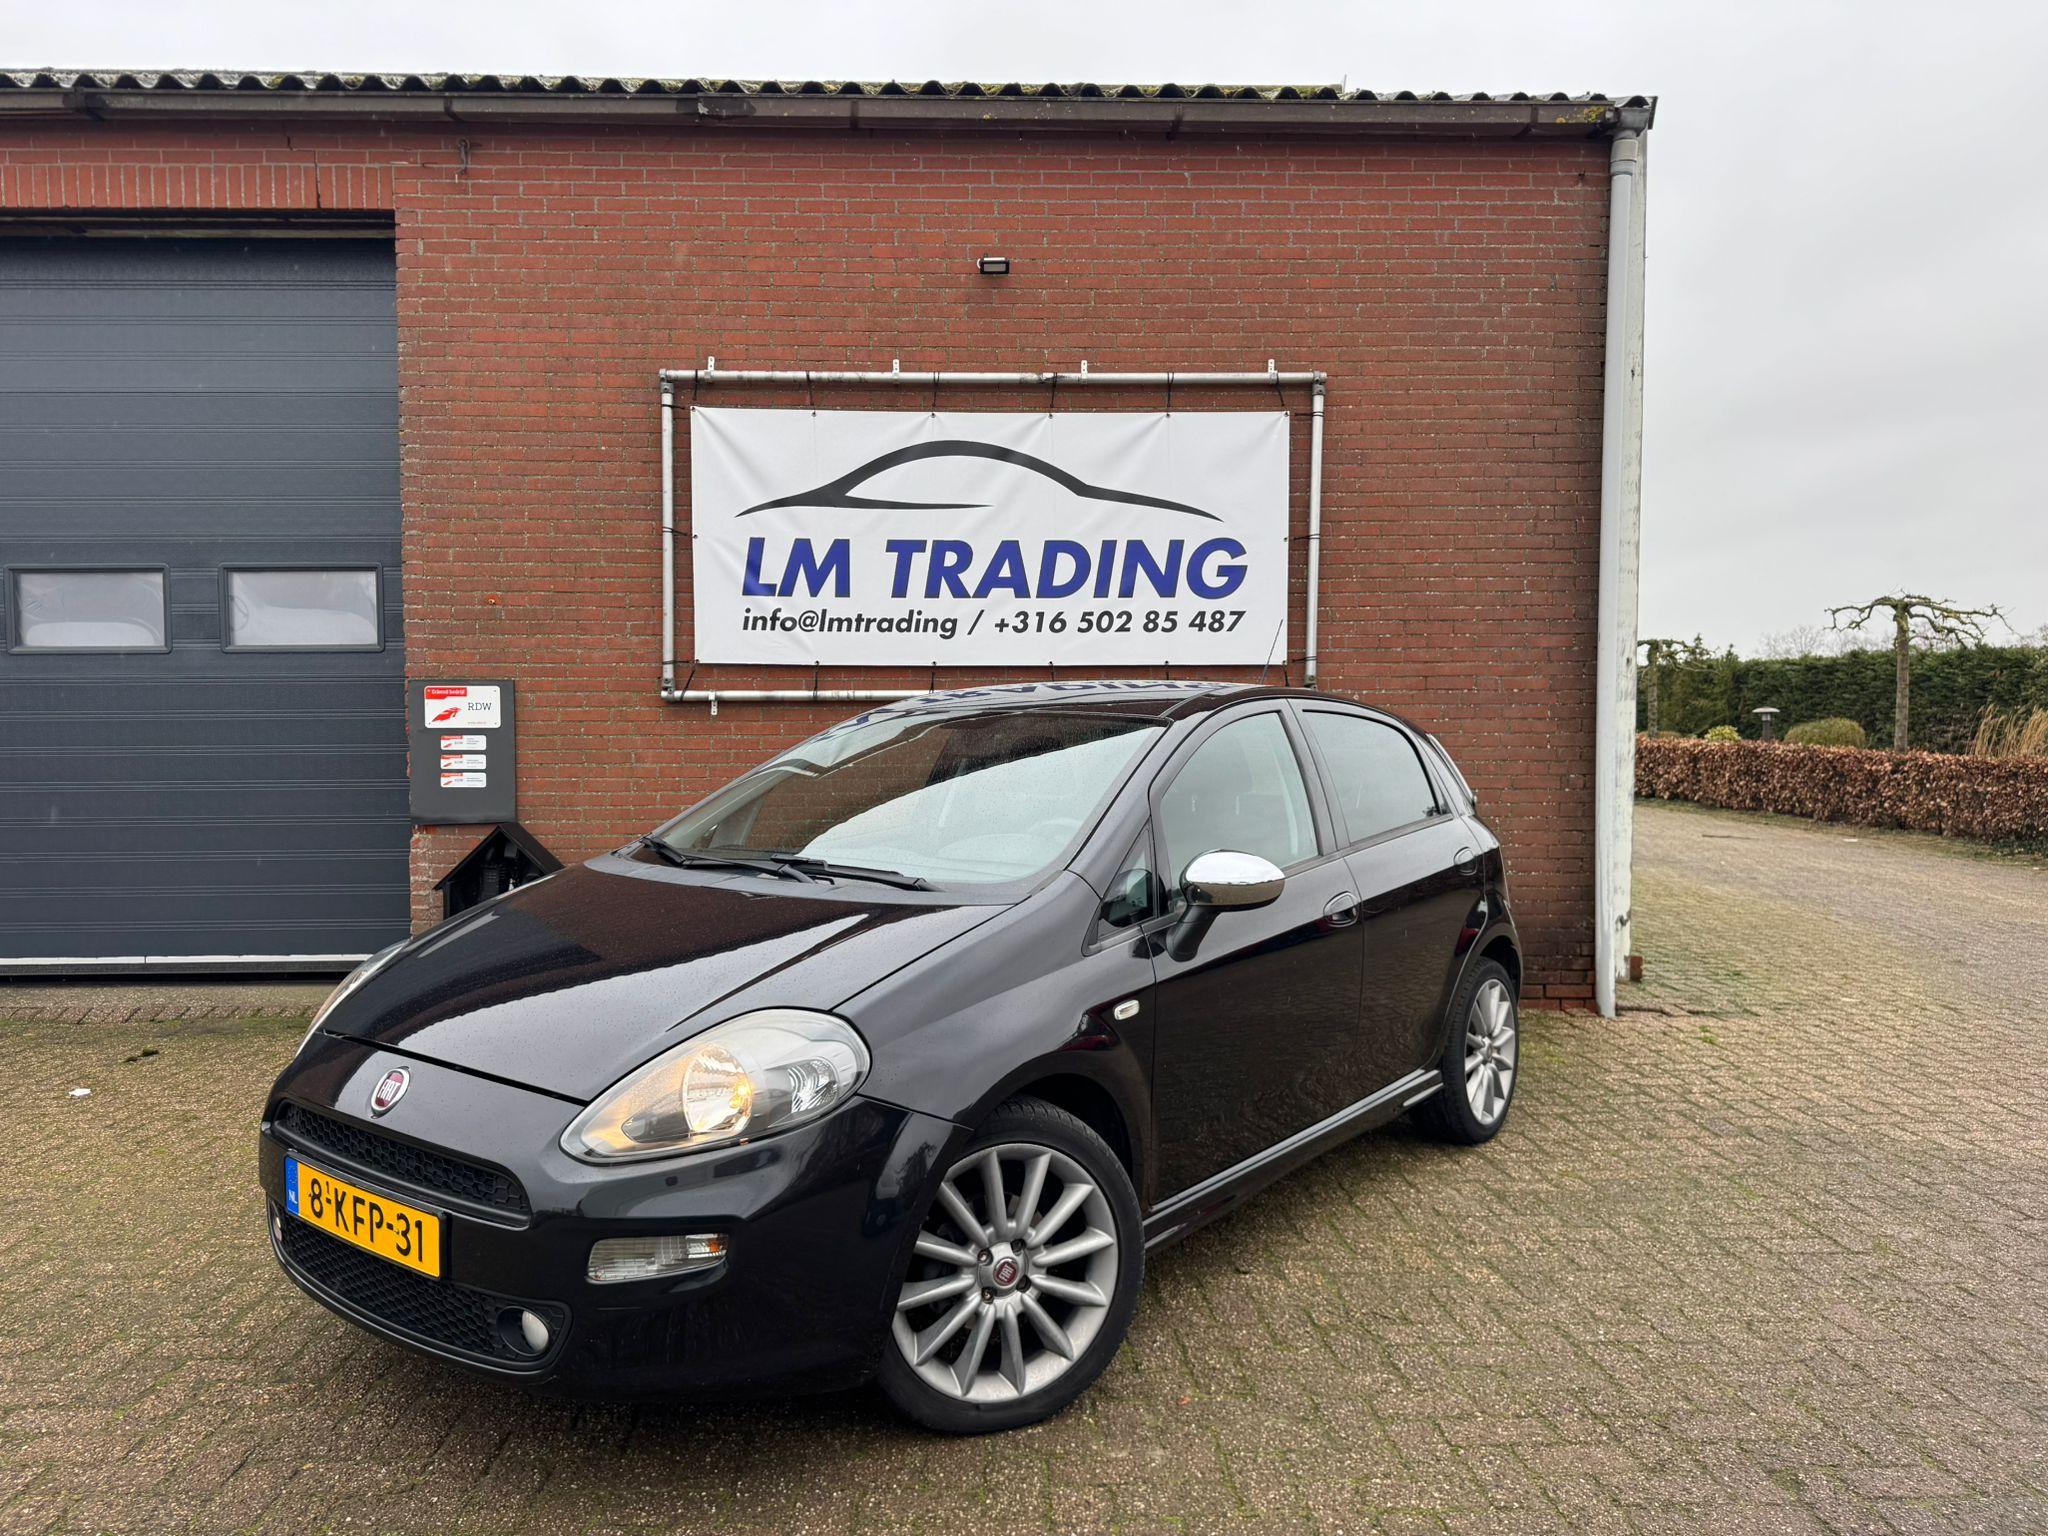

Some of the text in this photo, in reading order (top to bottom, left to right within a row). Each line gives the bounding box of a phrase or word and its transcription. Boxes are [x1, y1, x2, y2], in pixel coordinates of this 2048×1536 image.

[742, 537, 1247, 599] LM TRADING
[742, 608, 1246, 639] info@lmtrading / +316 502 85 487
[467, 702, 492, 711] RDW
[377, 1079, 401, 1101] FIAT
[999, 1263, 1013, 1281] FIAT
